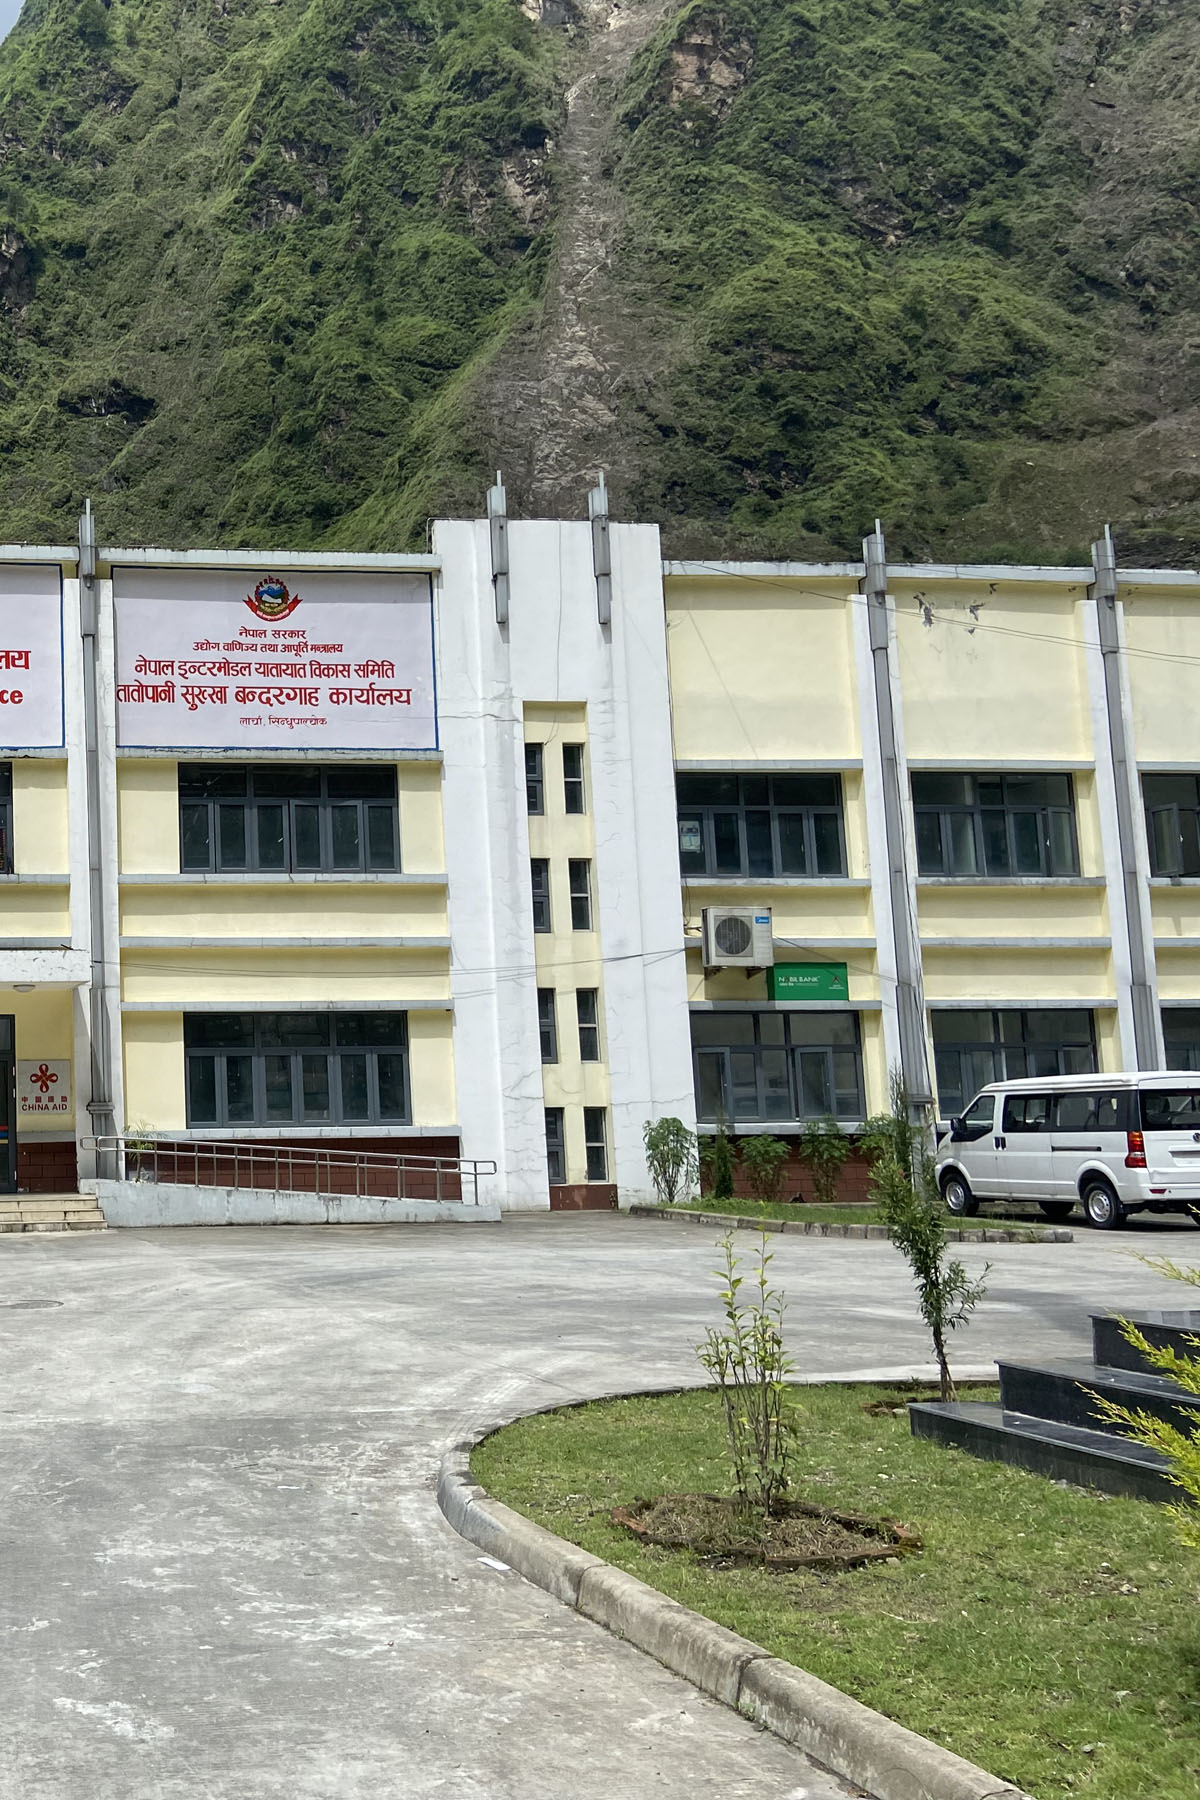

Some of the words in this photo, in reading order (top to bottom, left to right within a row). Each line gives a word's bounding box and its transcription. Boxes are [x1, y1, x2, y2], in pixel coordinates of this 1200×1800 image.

[239, 626, 267, 638] नेपाल
[271, 629, 307, 640] सरकार
[192, 639, 220, 651] उद्योग
[260, 642, 278, 653] तथा
[280, 641, 309, 658] आपूर्ति
[310, 643, 343, 654] मन्त्रालय
[135, 655, 175, 676] नेपाल
[178, 657, 252, 679] इन्टरमोडल
[254, 662, 307, 678] यातायात
[309, 660, 351, 678] विकास
[353, 660, 395, 678] समिति
[116, 679, 176, 703] तातोपानी
[235, 686, 320, 707] बन्दरगाह
[329, 682, 413, 706] कार्यालय
[52, 1103, 68, 1111] AID
